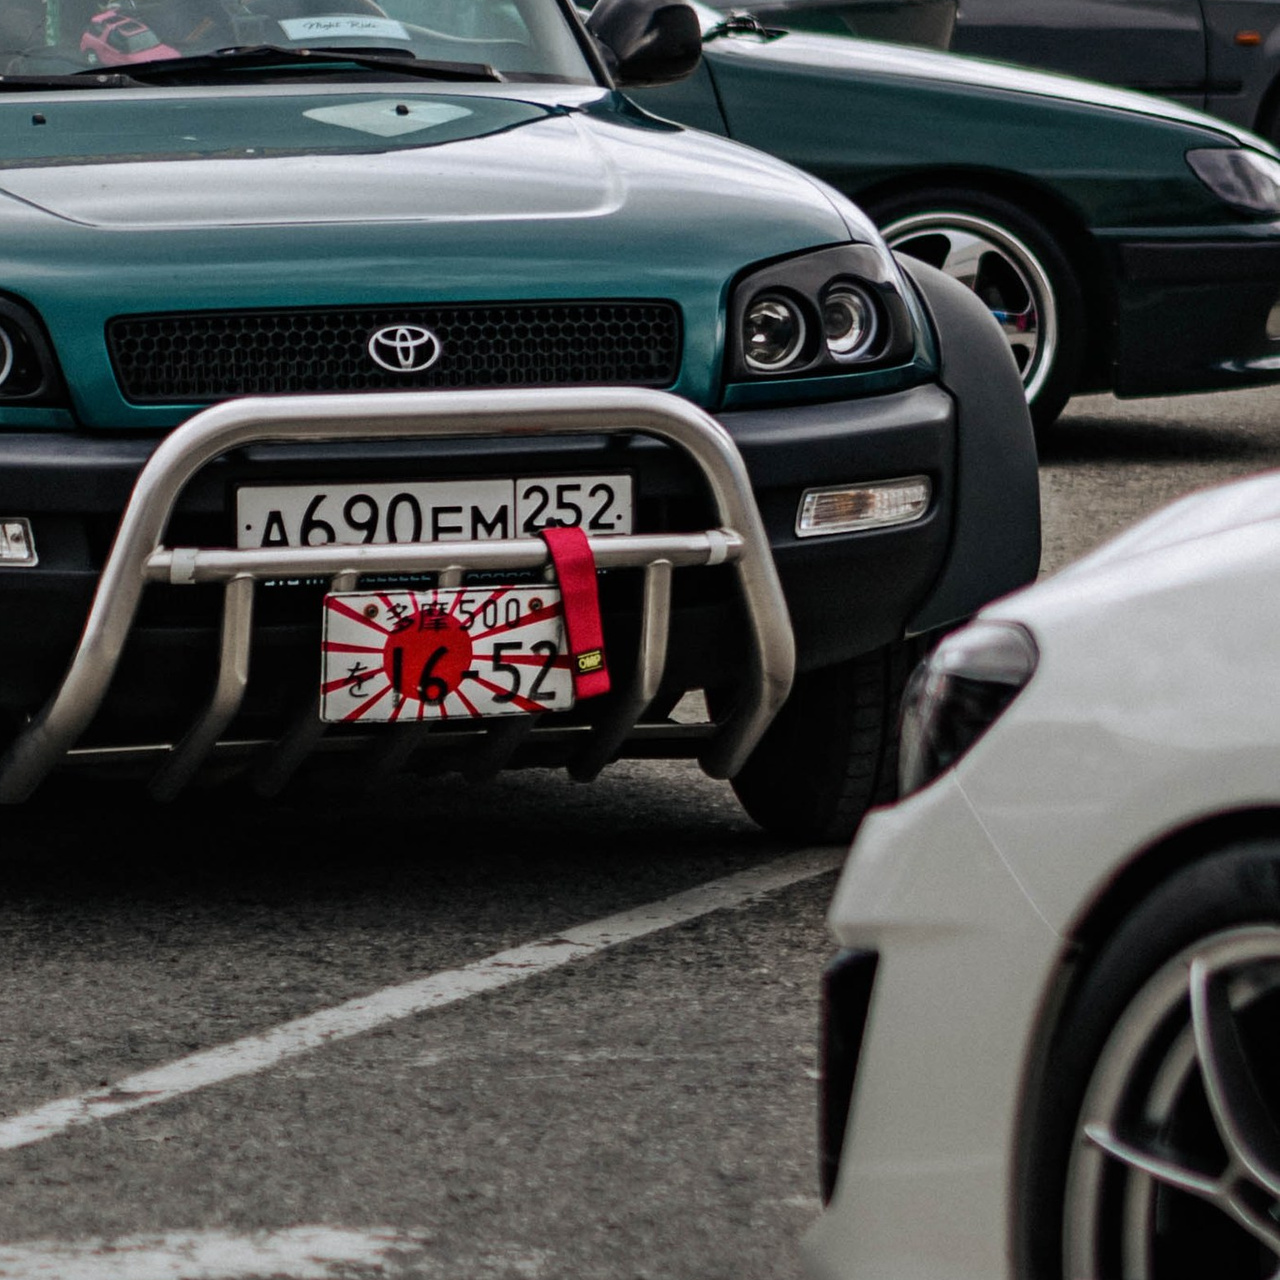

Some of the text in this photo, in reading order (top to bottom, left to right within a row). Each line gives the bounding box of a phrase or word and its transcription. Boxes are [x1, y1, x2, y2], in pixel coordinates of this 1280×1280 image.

[522, 483, 616, 533] 252
[385, 597, 521, 634] 多摩 500
[344, 639, 559, 708] を 16-52
[577, 654, 602, 670] OMP
